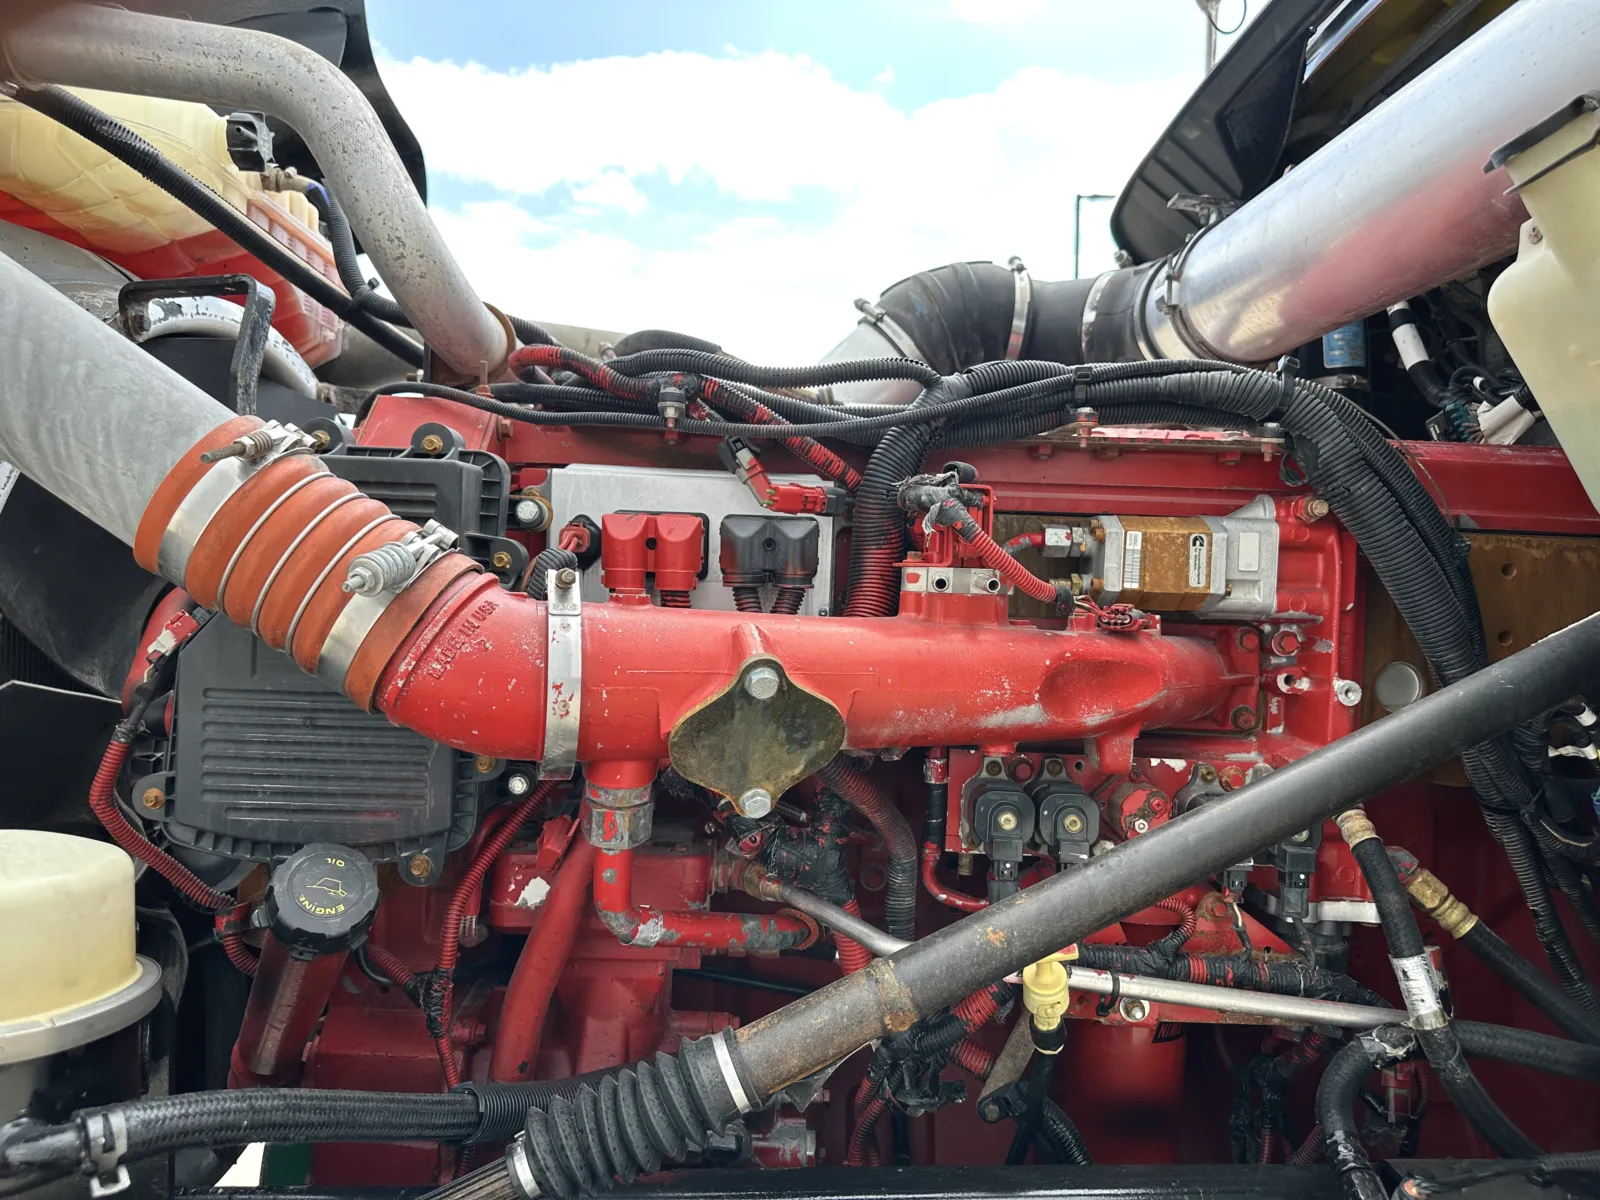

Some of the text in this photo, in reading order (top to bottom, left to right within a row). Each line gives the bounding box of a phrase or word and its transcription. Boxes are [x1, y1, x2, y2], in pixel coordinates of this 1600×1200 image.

[427, 601, 499, 680] MADE IN USA
[326, 857, 345, 867] OIL
[298, 894, 345, 915] ENGINE
